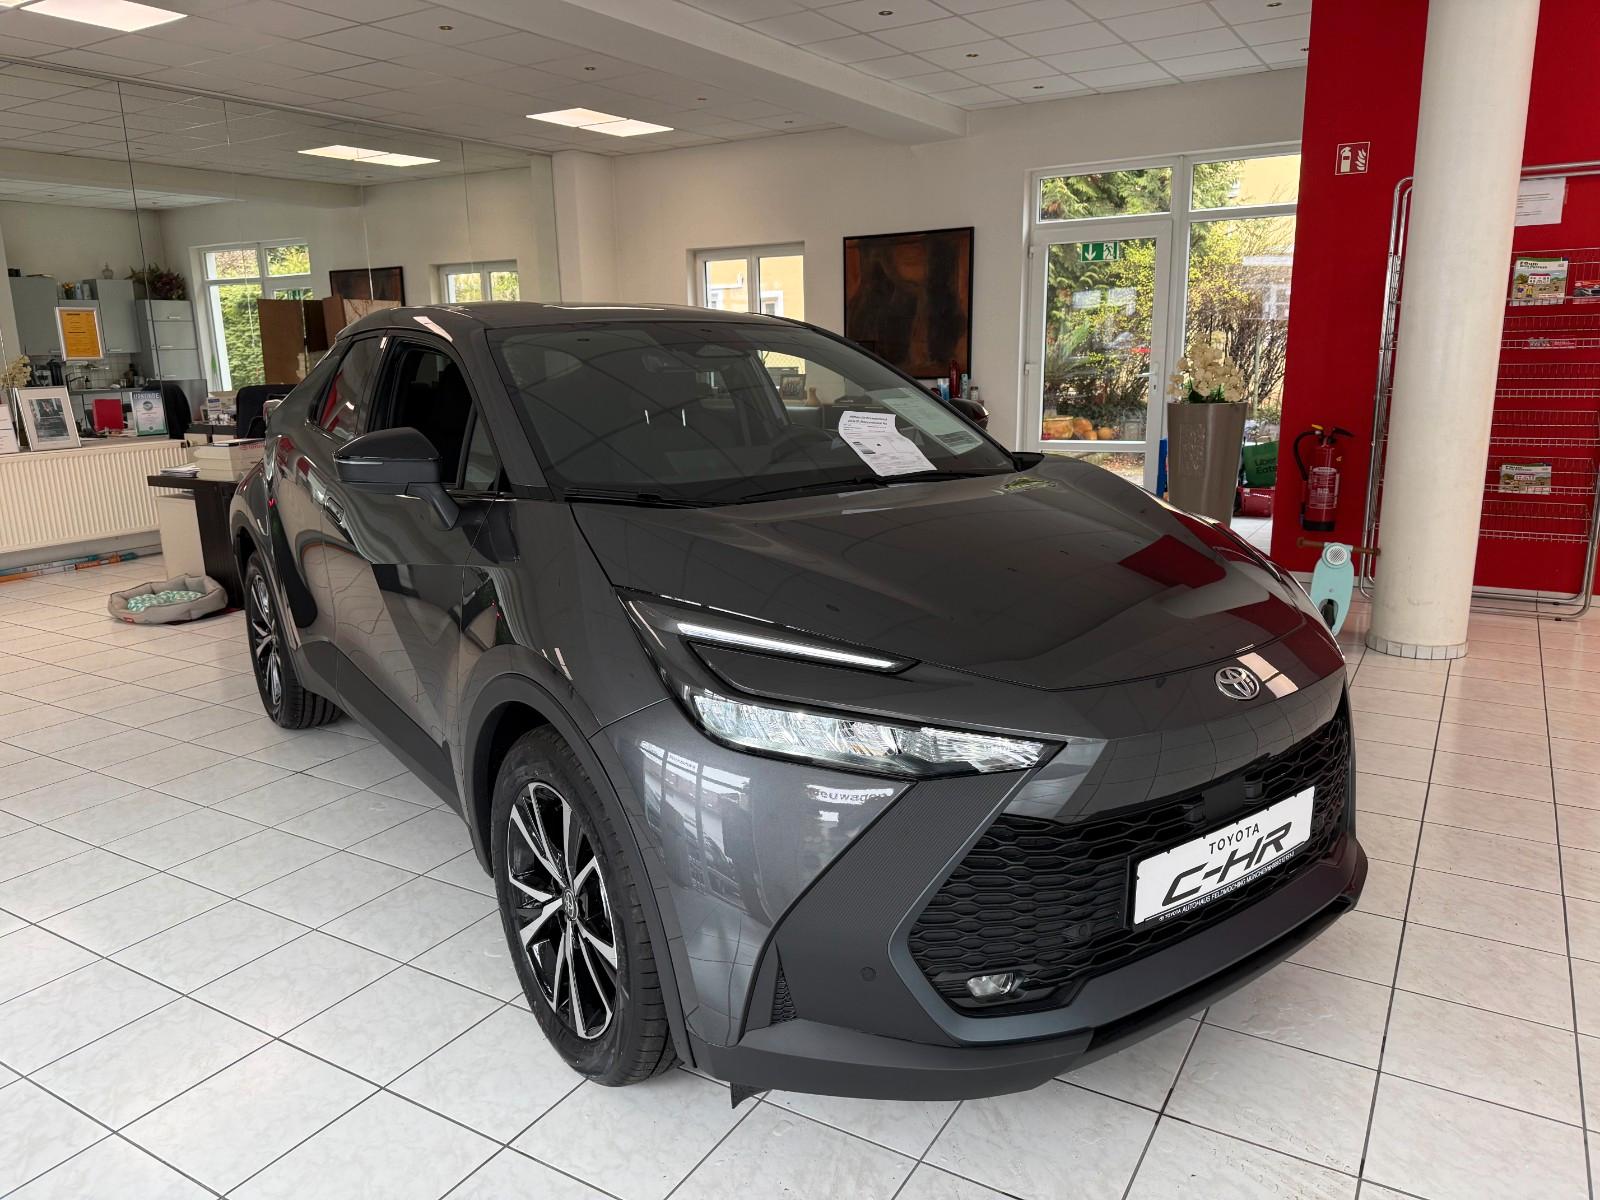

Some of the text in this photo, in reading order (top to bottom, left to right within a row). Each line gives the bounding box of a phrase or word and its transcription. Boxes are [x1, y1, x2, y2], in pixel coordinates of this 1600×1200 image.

[1209, 823, 1260, 855] TOYOTA
[1161, 821, 1293, 907] C-HR
[1182, 895, 1211, 914] AUTOHAUS
